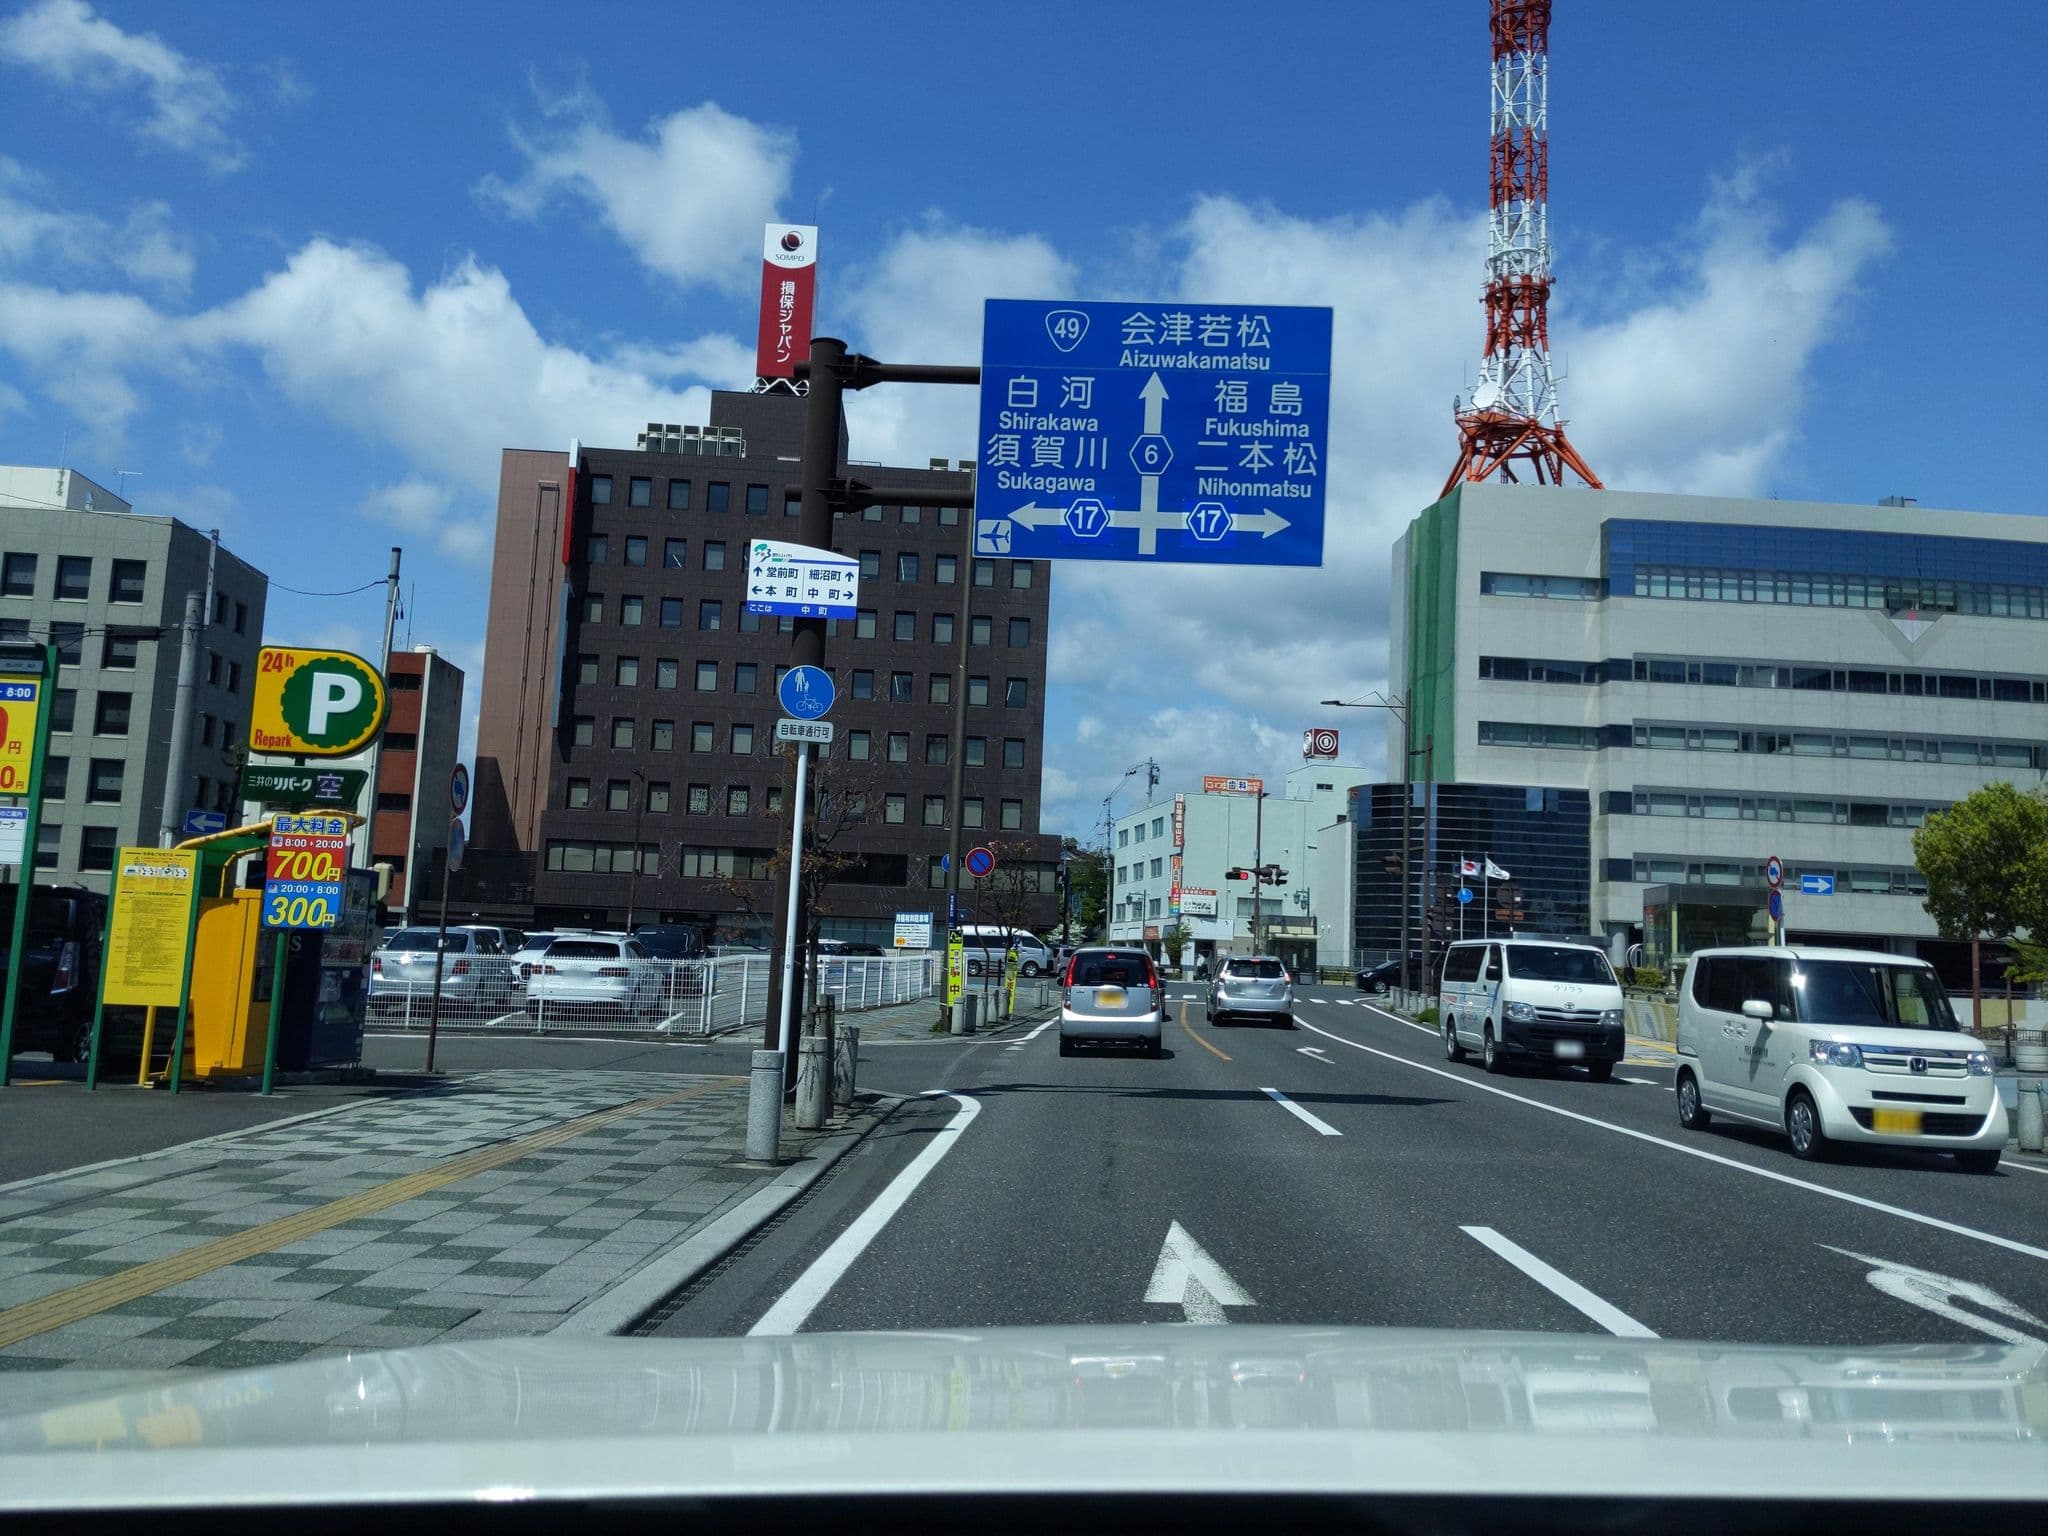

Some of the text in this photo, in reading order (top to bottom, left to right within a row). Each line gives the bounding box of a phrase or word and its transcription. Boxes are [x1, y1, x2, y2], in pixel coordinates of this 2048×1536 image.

[775, 254, 805, 262] SOMPO
[777, 280, 796, 363] 損保ジャパン
[1054, 317, 1080, 339] 49
[1122, 311, 1271, 349] 会津若松
[1119, 349, 1270, 370] Aizuwakamatsu
[1008, 374, 1096, 409] 白河
[1214, 379, 1303, 416] 福島
[999, 411, 1098, 432] Shirakawa
[1205, 417, 1309, 437] Fukushima
[986, 433, 1108, 470] 須賀川
[1144, 444, 1158, 465] 6
[1194, 440, 1318, 476] 二本松
[997, 470, 1096, 494] Sukagawa
[1198, 477, 1312, 498] Nihonmatsu
[1074, 506, 1099, 530] 17
[1196, 509, 1222, 534] 17
[766, 566, 799, 580] 堂前町
[808, 569, 842, 582] 細沼町
[765, 585, 798, 598] 本町
[807, 587, 841, 600] 中町
[6, 687, 31, 698] 8:00
[307, 672, 362, 735] P
[254, 729, 292, 748] Repark
[781, 724, 830, 739] 自転車通行可
[248, 773, 344, 799] 三井のリパーク 空
[276, 816, 343, 834] 最大料金
[285, 838, 343, 849] 8:00 20:00
[273, 850, 340, 881] 700円
[281, 884, 339, 894] 20:00 8:00
[267, 896, 335, 927] 300円
